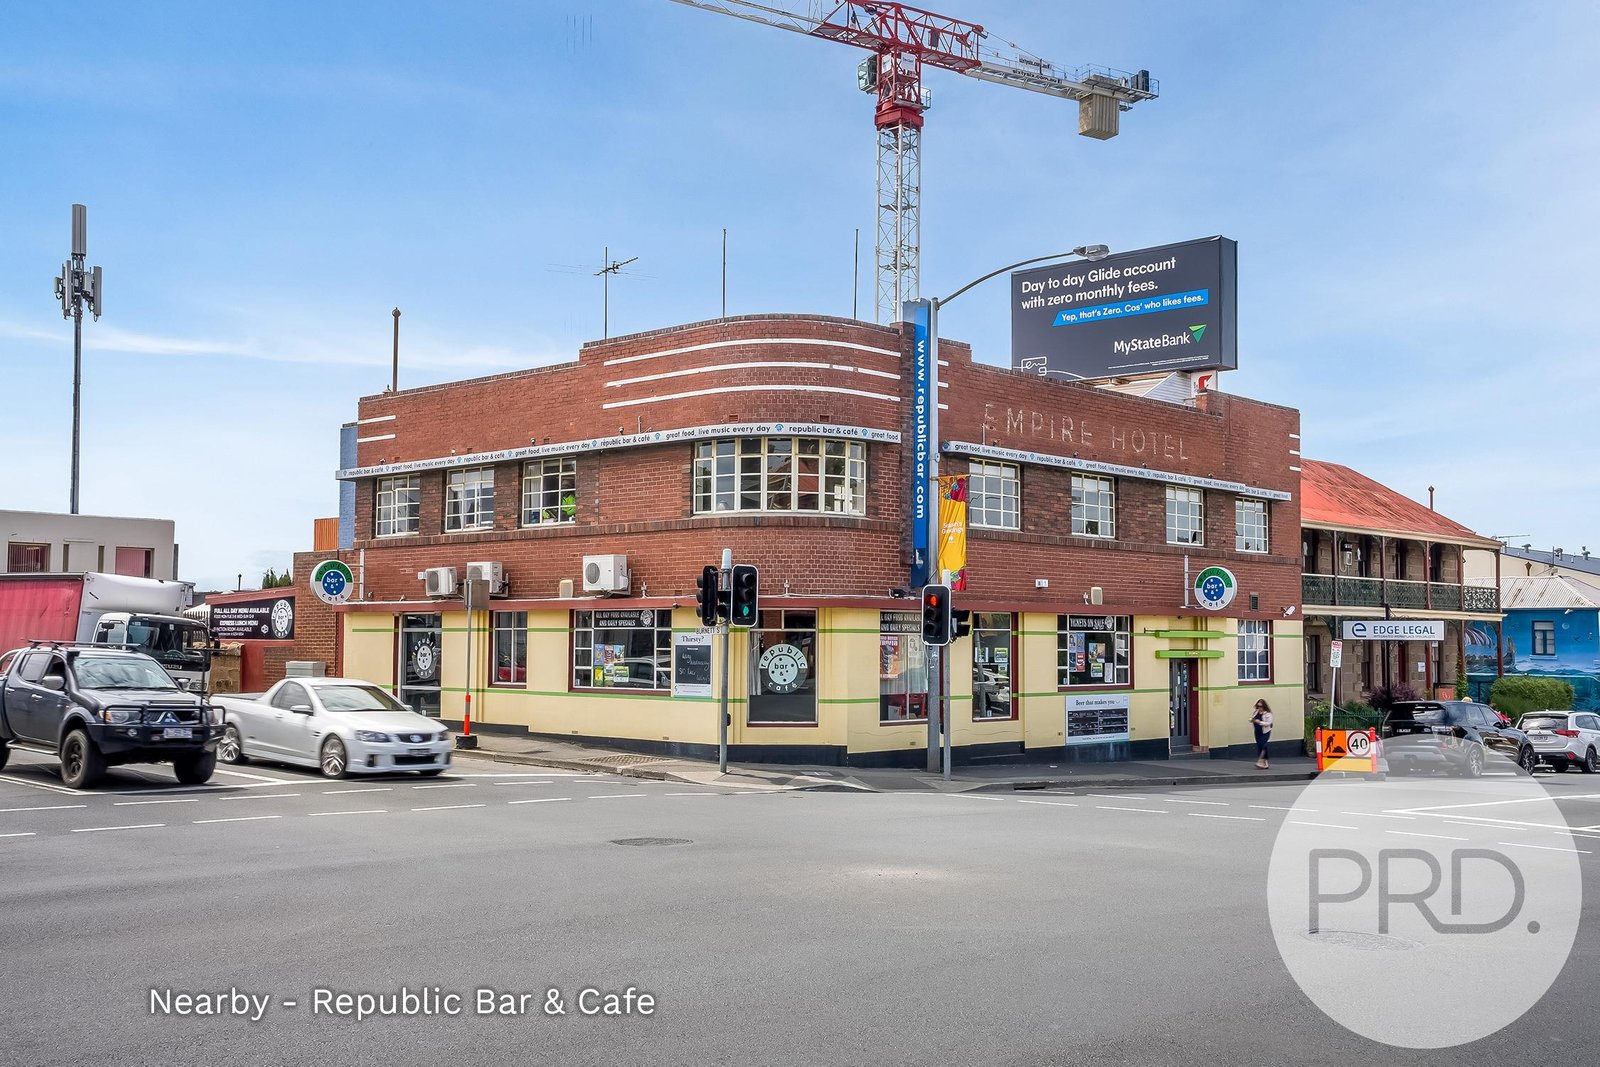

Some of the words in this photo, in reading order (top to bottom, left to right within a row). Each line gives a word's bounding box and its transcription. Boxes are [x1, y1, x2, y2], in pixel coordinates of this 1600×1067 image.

[1022, 282, 1046, 294] Day
[1048, 278, 1059, 288] to
[1063, 274, 1085, 288] day
[1088, 269, 1120, 283] Glide
[1124, 257, 1176, 277] account
[1022, 297, 1044, 310] with
[1048, 293, 1073, 306] zero
[1076, 284, 1125, 302] monthly
[1128, 280, 1158, 292] fees.
[1062, 314, 1078, 322] Yep,
[1080, 310, 1101, 319] that's
[1103, 307, 1122, 316] Zero.
[1124, 303, 1142, 312] Cos'
[1144, 301, 1160, 309] who
[1162, 298, 1182, 306] likes
[1184, 295, 1204, 303] fees.
[1114, 332, 1190, 355] MyStateBank
[666, 432, 680, 440] great
[732, 425, 754, 433] every
[789, 425, 820, 433] republic
[823, 425, 835, 434] bar
[843, 426, 858, 435] café
[916, 340, 926, 519] www.republicbar.com
[984, 404, 1093, 446] EMPIRE
[1112, 426, 1190, 460] HOTEL
[600, 437, 621, 447] republic
[886, 433, 899, 441] food,
[494, 450, 505, 458] café
[515, 449, 527, 457] great
[970, 445, 981, 453] food,
[1036, 455, 1053, 463] republic
[1373, 626, 1399, 634] EDGE
[1403, 626, 1435, 634] LEGAL
[760, 646, 806, 668] republic
[768, 682, 797, 692] café
[1351, 738, 1368, 750] 40
